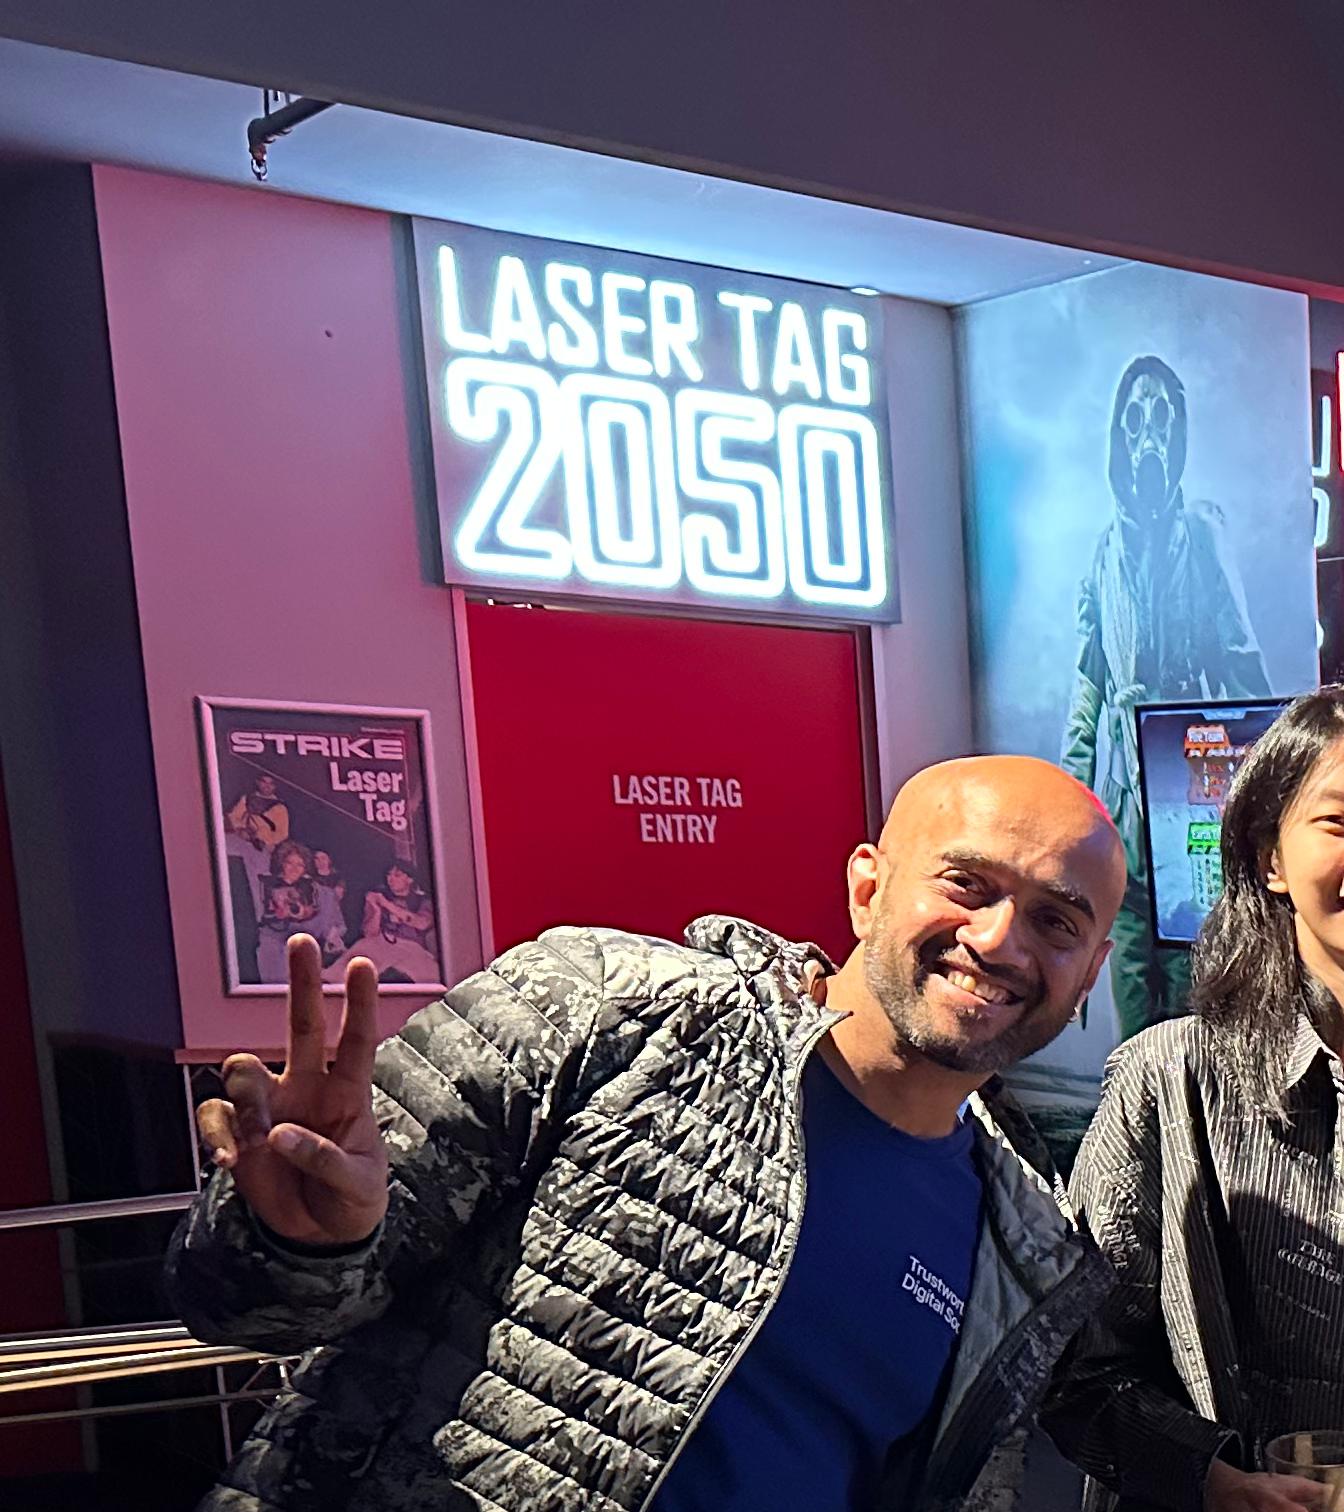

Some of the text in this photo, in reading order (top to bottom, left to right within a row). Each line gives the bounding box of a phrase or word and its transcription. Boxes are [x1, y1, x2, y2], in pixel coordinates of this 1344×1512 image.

[438, 244, 871, 407] LASER TAG
[445, 356, 888, 608] 2050
[230, 731, 404, 761] STRIKE
[329, 761, 404, 794] Laser
[612, 774, 743, 808] LASER TAG
[358, 792, 408, 832] Tag
[640, 812, 718, 843] ENTRY
[901, 1273, 946, 1316] Digital
